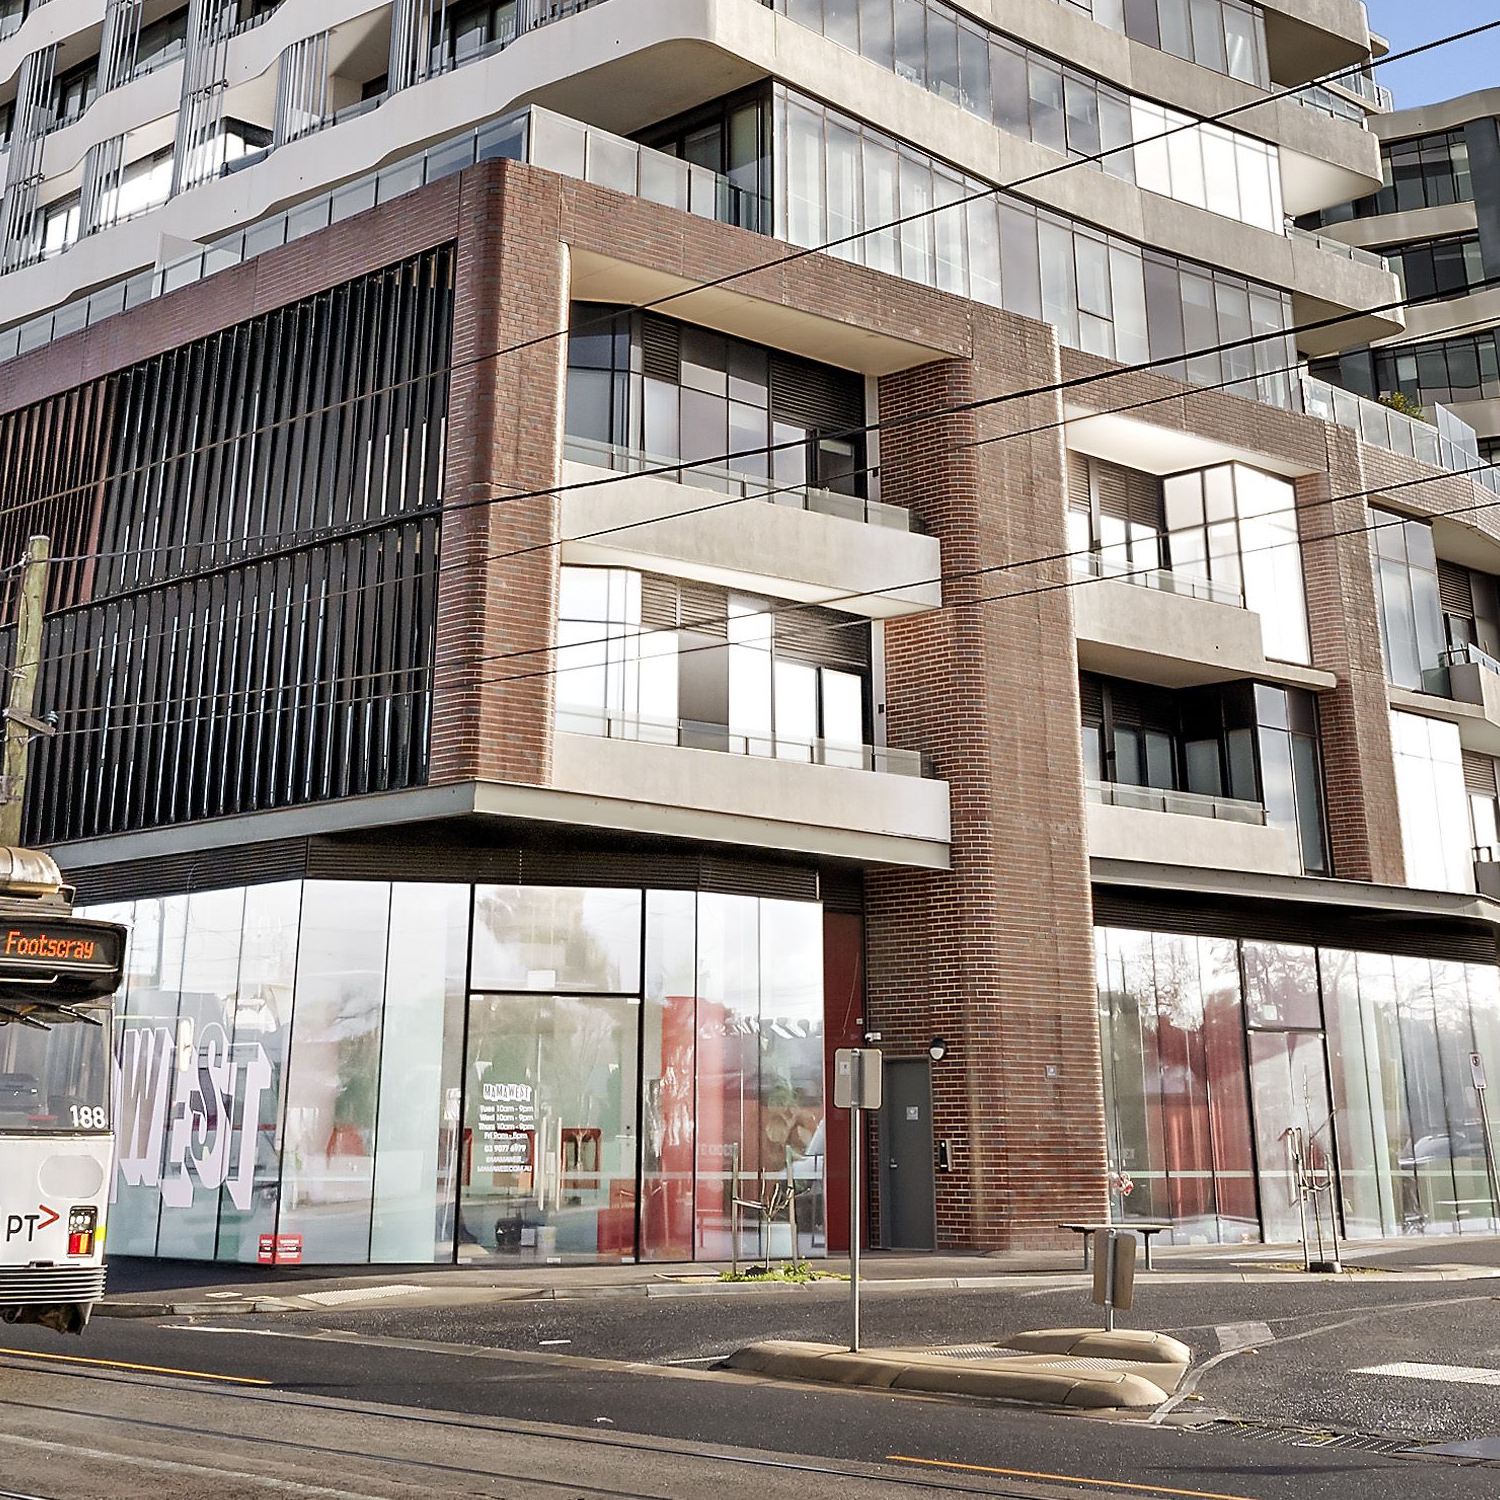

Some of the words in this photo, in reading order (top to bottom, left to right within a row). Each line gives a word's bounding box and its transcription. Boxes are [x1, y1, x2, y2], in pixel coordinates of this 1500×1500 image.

[5, 929, 95, 960] Footscray
[483, 1083, 533, 1102] MAMAWEST
[69, 1104, 107, 1129] 188
